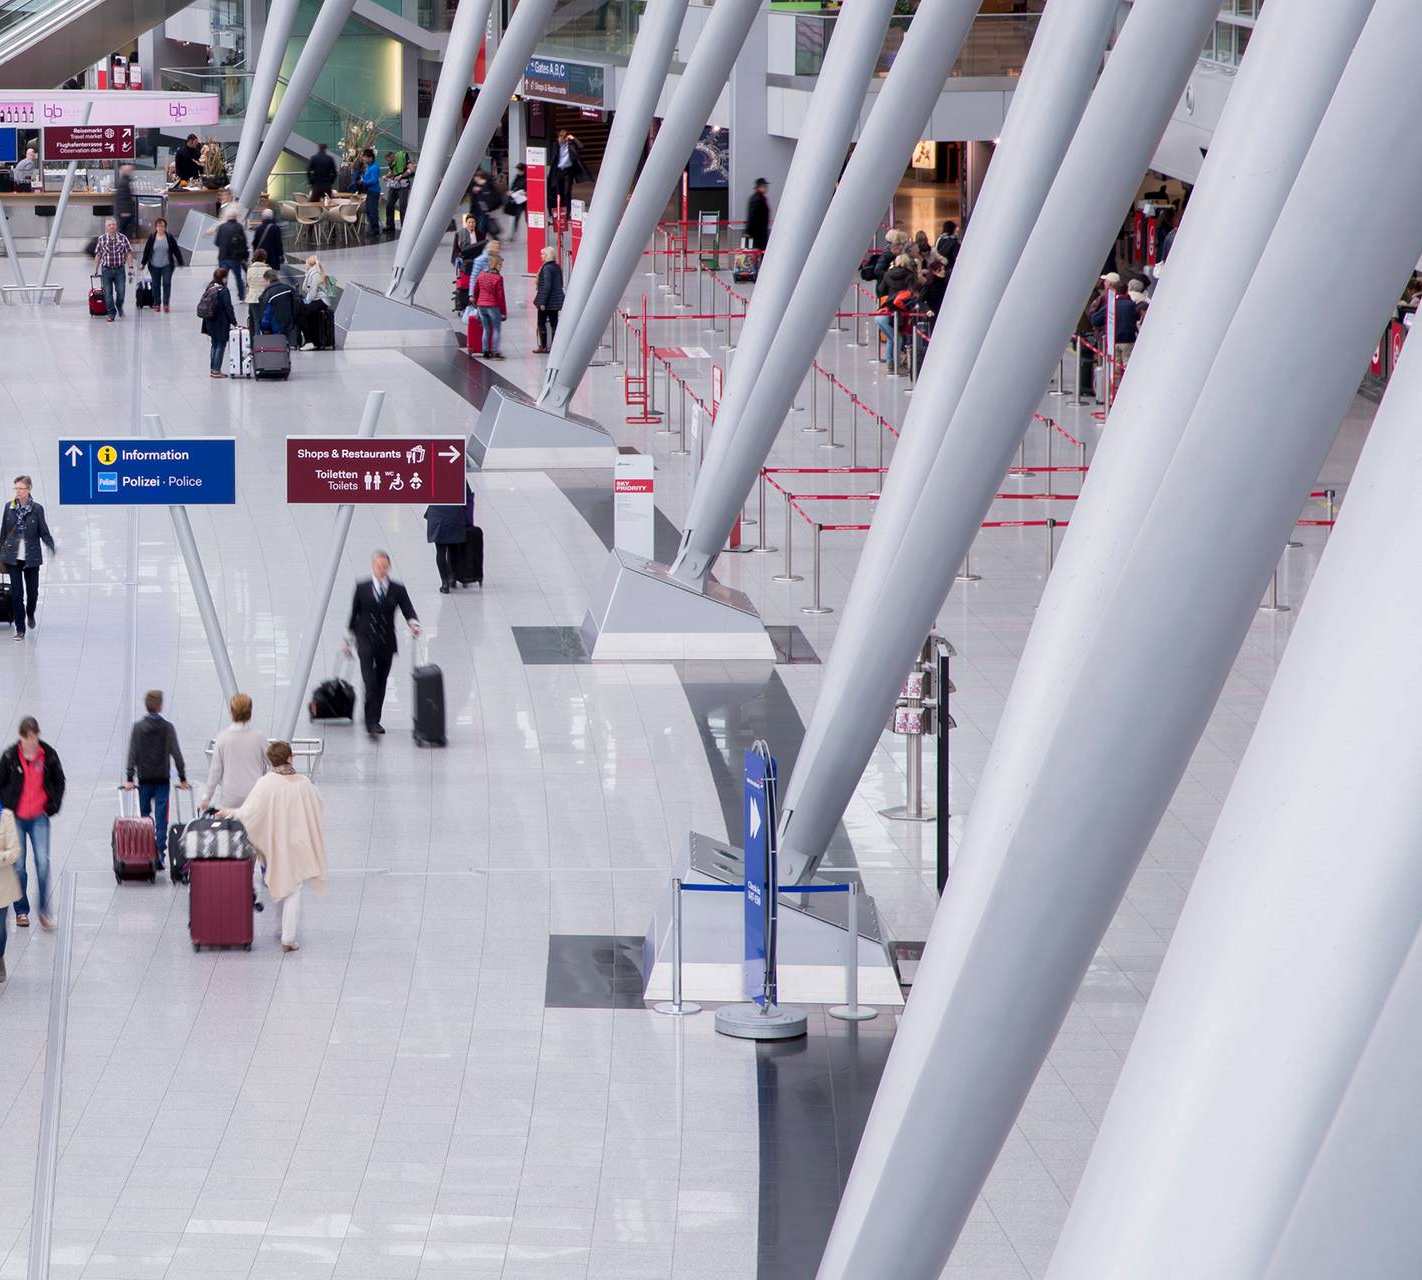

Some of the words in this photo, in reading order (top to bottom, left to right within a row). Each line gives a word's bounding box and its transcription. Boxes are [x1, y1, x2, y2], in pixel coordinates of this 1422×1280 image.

[535, 62, 549, 74] Gates
[122, 450, 190, 461] Information
[297, 449, 330, 460] Shops
[331, 449, 340, 459] &
[342, 449, 402, 459] Restaurants
[315, 470, 358, 479] Toiletten
[122, 476, 160, 487] Polizei
[168, 476, 202, 487] Police
[328, 481, 358, 491] Toilets
